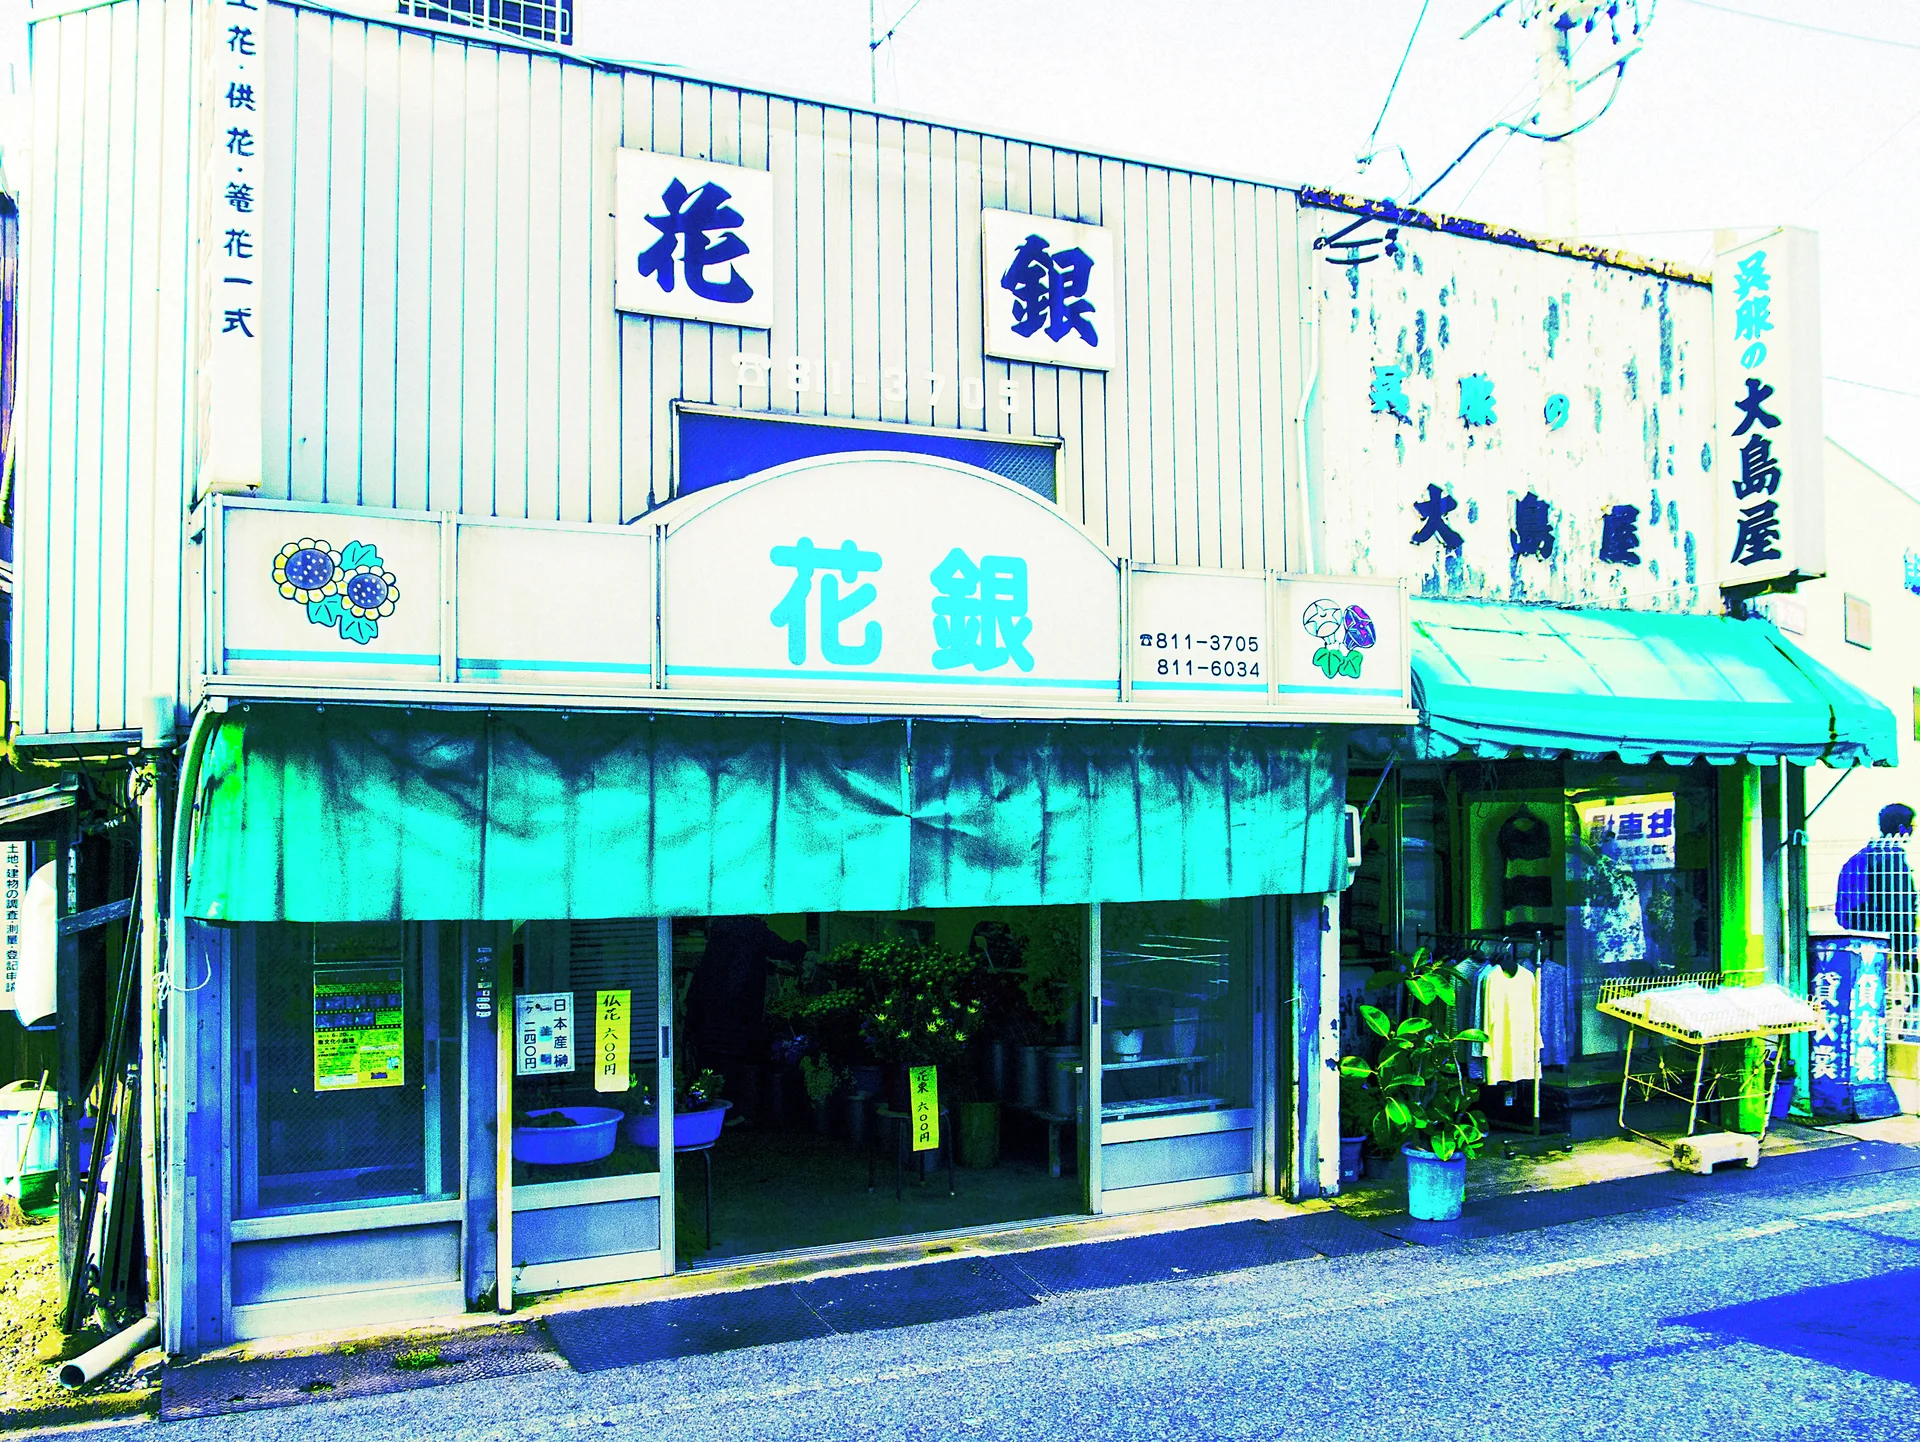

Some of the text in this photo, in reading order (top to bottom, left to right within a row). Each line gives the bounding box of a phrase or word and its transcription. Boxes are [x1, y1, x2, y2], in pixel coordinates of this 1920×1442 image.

[1408, 483, 1643, 566] 大島屋
[1155, 632, 1259, 652] 811-3705
[1157, 658, 1260, 678] 811-6034
